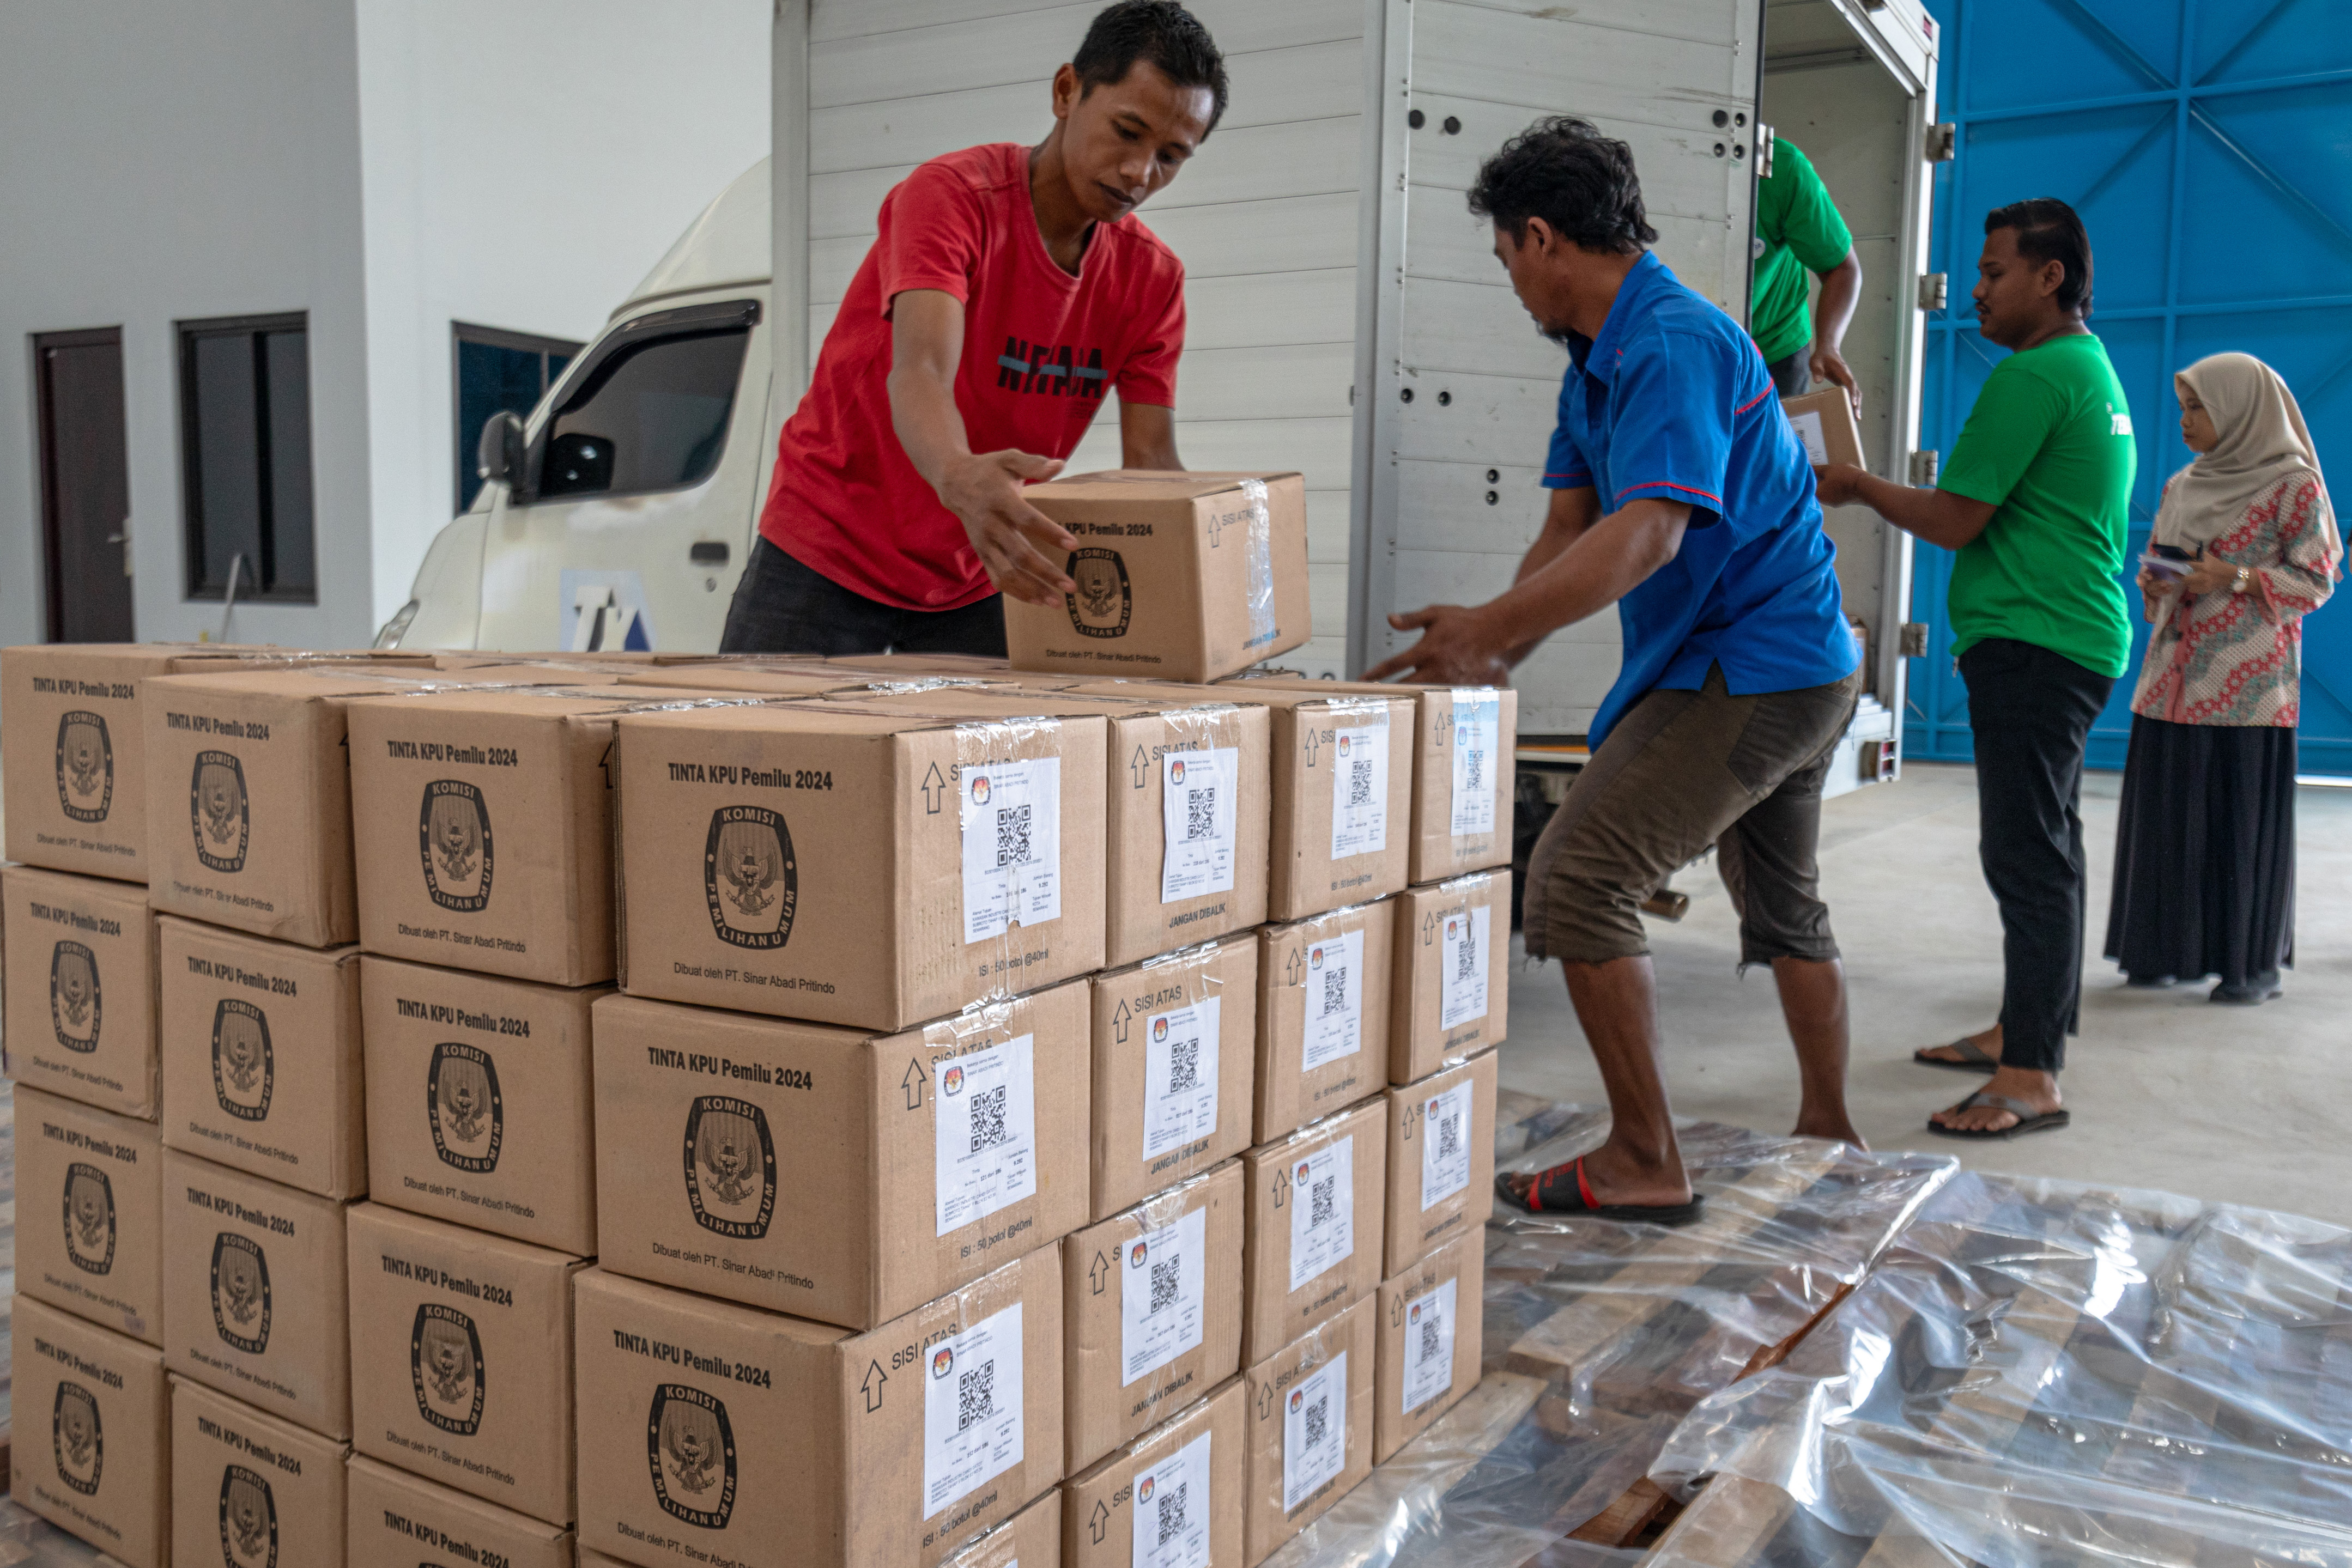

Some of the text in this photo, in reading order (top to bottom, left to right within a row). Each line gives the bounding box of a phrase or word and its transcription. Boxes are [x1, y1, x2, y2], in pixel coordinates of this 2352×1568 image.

[1088, 522, 1124, 536] Pemilu
[1126, 524, 1153, 536] 2024
[33, 677, 134, 700] TINTA KPU Pemilu 2024
[167, 712, 270, 741] TINTA KPU Pemilu 2024
[388, 740, 518, 767] TINTA KPU Pemilu 2024
[432, 782, 474, 799] KOMISI
[668, 763, 833, 791] TINTA KPU Pemilu 2024
[723, 808, 775, 825] KOMISI
[30, 902, 120, 937] TINTA KPU Pemilu 2024
[1169, 903, 1226, 928] JANGAN DIBALIK
[399, 923, 421, 937] Dibuat
[423, 927, 438, 939] oleh
[454, 932, 473, 945] Sinar
[474, 935, 495, 949] Abadi
[498, 938, 526, 953] Pritindo
[187, 957, 297, 997] TINTA KPU Pemilu 2024
[979, 964, 989, 977] ISI
[1025, 948, 1048, 966] @40ml
[674, 962, 702, 977] Dibuat
[704, 967, 723, 980] oleh
[744, 971, 768, 986] Sinar
[769, 975, 796, 989] Abadi
[799, 979, 835, 994] Pritindo
[1135, 986, 1181, 1013] SISI ATAS
[397, 999, 530, 1038] TINTA KPU Pemilu 2024
[441, 1045, 484, 1064] KOMISI
[648, 1047, 813, 1091] TINTA KPU Pemilu 2024
[702, 1098, 755, 1119] KOMISI
[187, 1187, 295, 1237] TINTA KPU Pemilu 2024
[404, 1176, 427, 1191] Dibuat
[429, 1183, 444, 1195] oleh
[460, 1190, 480, 1204] Sinar
[481, 1196, 503, 1211] Abadi
[505, 1201, 535, 1218] Pritindo
[961, 1245, 971, 1259] ISI
[977, 1238, 986, 1251] 50
[1008, 1216, 1032, 1238] @40ml
[652, 1243, 681, 1260] Dibuat
[682, 1251, 701, 1264] oleh
[722, 1259, 746, 1274] Sinar
[382, 1255, 513, 1308] TINTA KPU Pemilu 2024
[614, 1330, 771, 1389] TINTA KPU Pemilu 2024
[892, 1342, 918, 1370] SISI
[665, 1386, 717, 1411] KOMISI
[1165, 1370, 1193, 1397] DIBALIK
[198, 1417, 301, 1476] TINTA KPU Pemilu 2024
[387, 1430, 409, 1447] Dibuat
[411, 1440, 426, 1453] oleh
[442, 1450, 462, 1466] Sinar
[463, 1458, 484, 1475] Abadi
[486, 1466, 515, 1486] Pritindo
[1113, 1483, 1133, 1508] SISI
[923, 1532, 933, 1549] ISI
[972, 1490, 997, 1517] @40ml
[384, 1510, 510, 1568] TINTA KPU Pemilu 2024
[618, 1522, 645, 1541] Dibuat
[647, 1534, 665, 1548] oleh
[685, 1546, 708, 1562] Sinar
